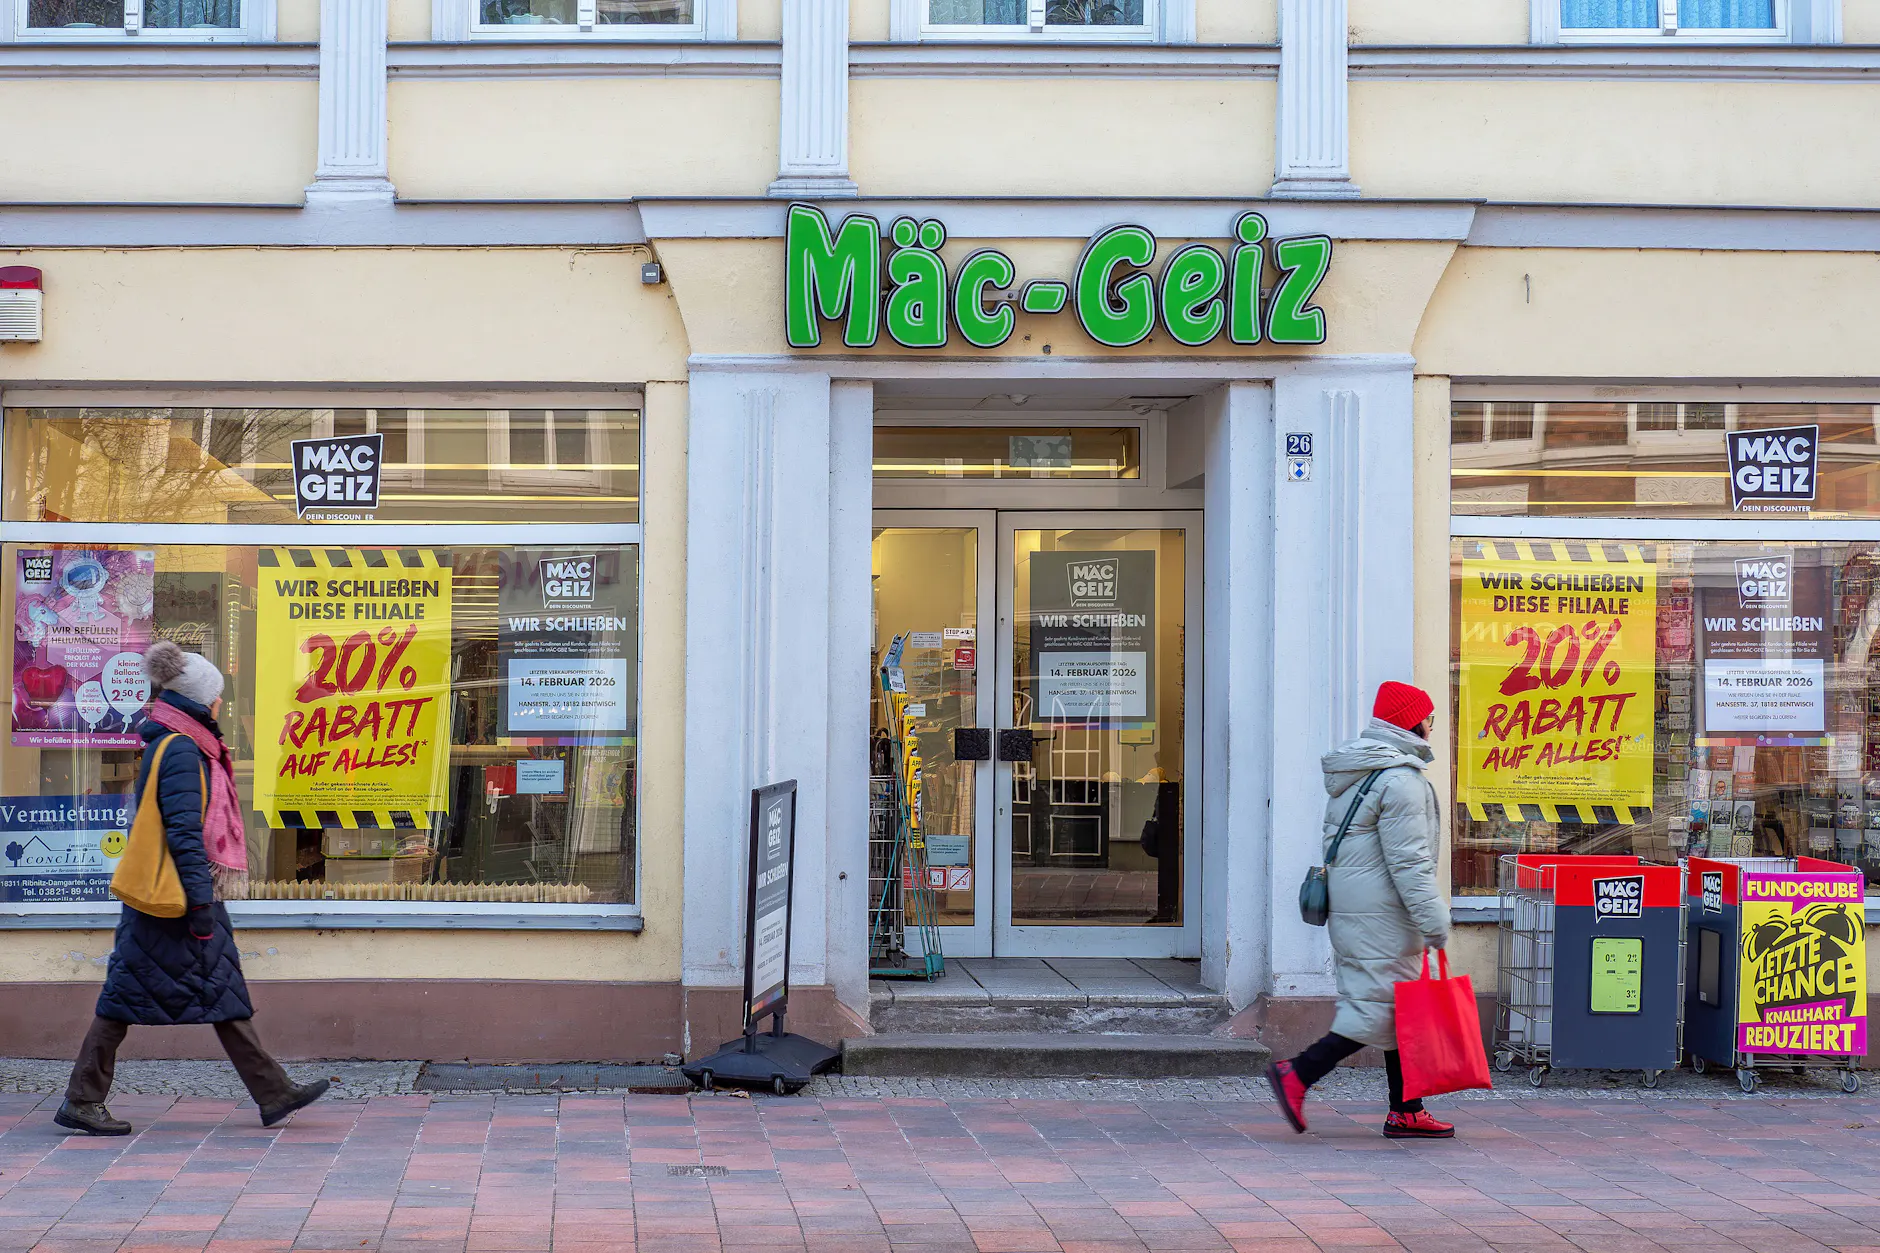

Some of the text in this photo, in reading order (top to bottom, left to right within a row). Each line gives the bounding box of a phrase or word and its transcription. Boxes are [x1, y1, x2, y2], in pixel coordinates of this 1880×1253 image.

[785, 201, 1333, 349] Mäc-Geiz
[1289, 435, 1310, 453] 26
[1738, 435, 1811, 463] MÄC
[302, 444, 374, 472] MÄC
[300, 474, 372, 500] GEIZ
[1736, 466, 1809, 492] GEIZ
[25, 558, 50, 569] MÄC
[547, 562, 590, 579] MÄC
[1074, 564, 1114, 580] MÄC
[1742, 562, 1786, 578] MÄC
[25, 569, 50, 579] GEIZ
[1479, 572, 1644, 592] WIR SCHLIEßEN
[275, 578, 439, 598] WIR SCHLIEßEN
[546, 580, 590, 596] GEIZ
[1072, 581, 1114, 596] GEIZ
[1741, 581, 1786, 596] GEIZ
[289, 602, 425, 620] DIESE FILIALE
[1494, 596, 1629, 615] DIESE FILIALE
[74, 625, 118, 634] BEFÜLLEN
[508, 616, 626, 631] WIR SCHLIEßEN
[1039, 613, 1146, 628] WIR SCHLIEßEN
[1704, 616, 1823, 631] WIR SCHLIEßEN
[295, 622, 418, 703] 20%
[1498, 618, 1622, 696] 20%
[521, 678, 616, 686] 14. FEBRUAR 2026
[1718, 678, 1813, 686] 14. FEBRUAR 2026
[112, 689, 144, 701] 2.50 €
[278, 696, 433, 749] RABATT
[1482, 692, 1637, 742] RABATT
[279, 750, 330, 780] AUF
[1482, 744, 1534, 771] AUF
[0, 804, 128, 827] Vermietung
[769, 808, 781, 827] MÄC
[768, 827, 780, 847] GEIZ
[26, 853, 95, 864] CONCILIA
[758, 872, 766, 889] WIR
[1599, 881, 1639, 897] MÄC
[1704, 875, 1721, 892] MÄC
[1746, 880, 1858, 898] FUNDGRUBE
[1598, 898, 1639, 913] GEIZ
[1704, 892, 1721, 908] GEIZ
[1759, 933, 1820, 980] LETZTE
[1754, 956, 1857, 1005] CHANCE
[1766, 1005, 1843, 1024] KNALLHART
[1746, 1023, 1856, 1052] REDUZIERT
